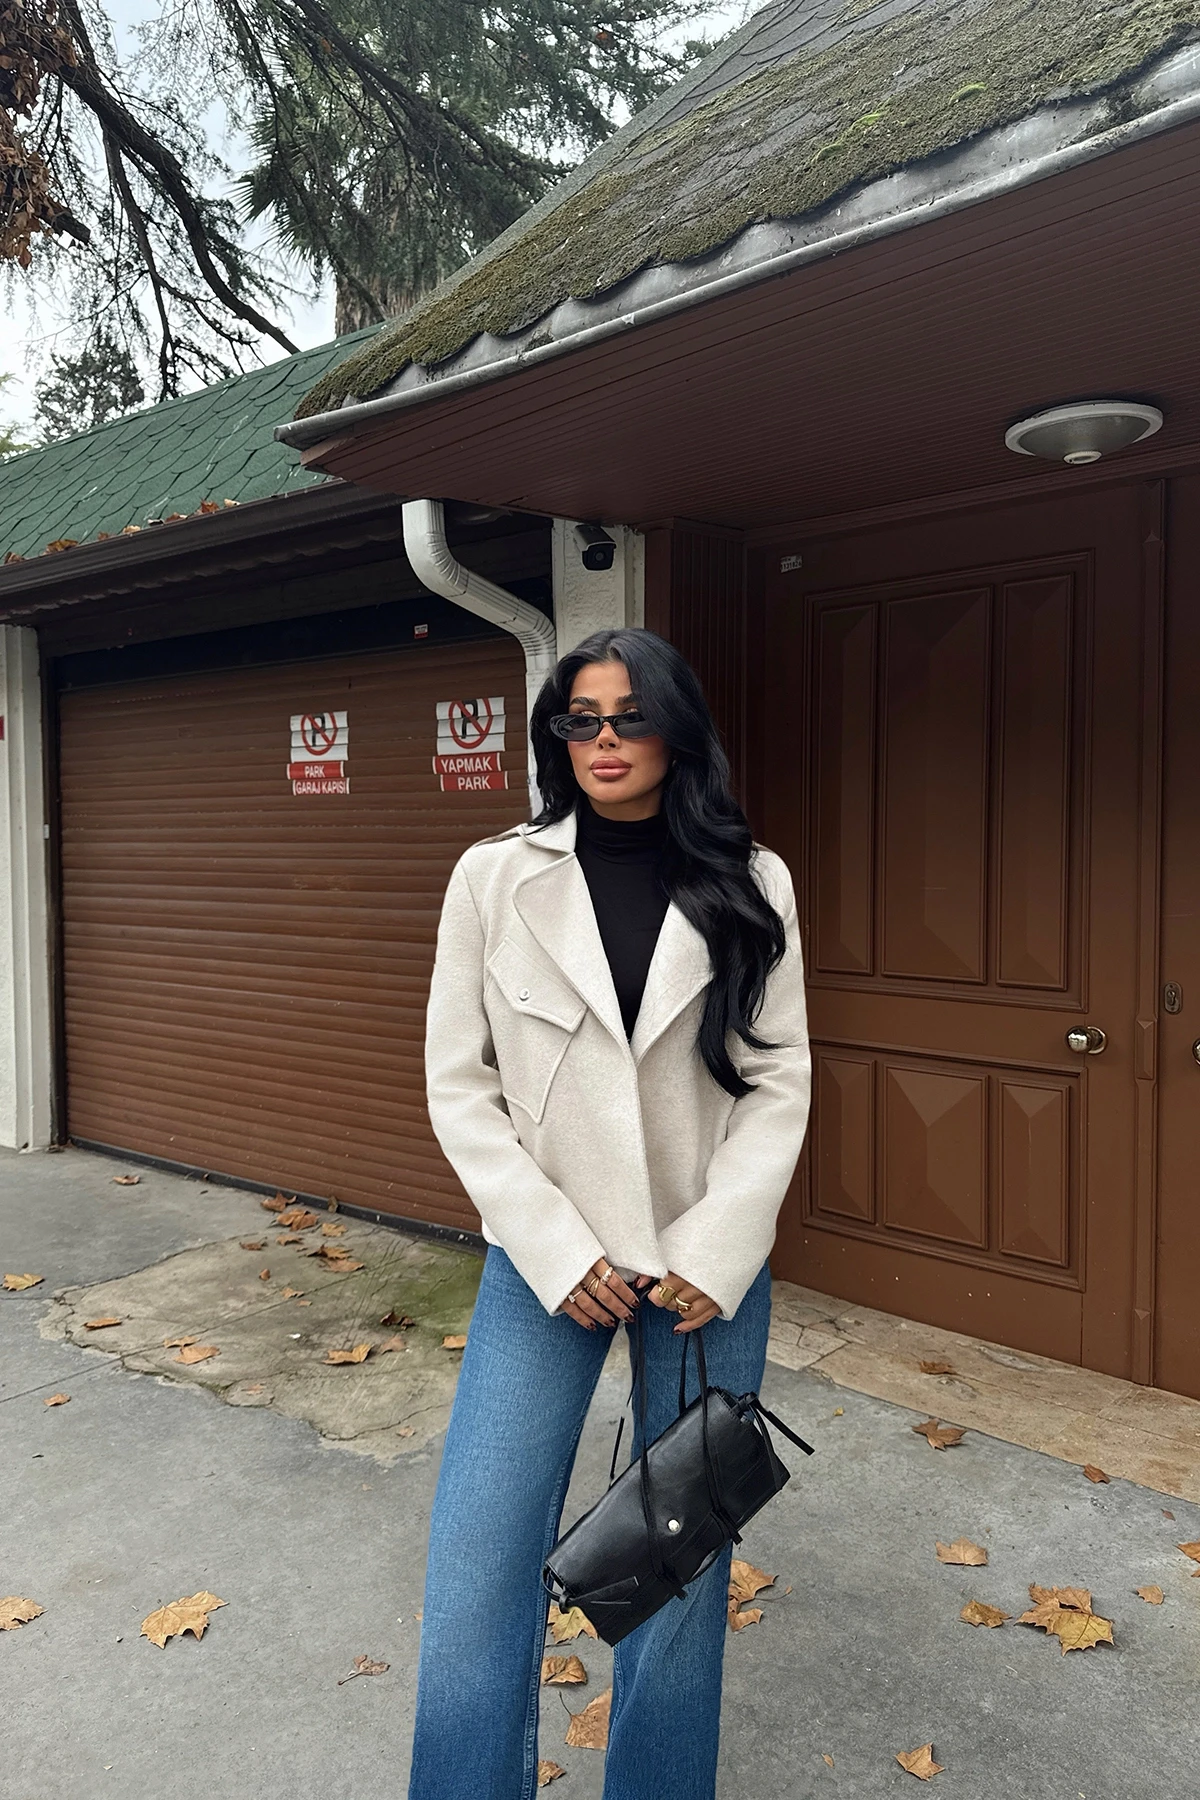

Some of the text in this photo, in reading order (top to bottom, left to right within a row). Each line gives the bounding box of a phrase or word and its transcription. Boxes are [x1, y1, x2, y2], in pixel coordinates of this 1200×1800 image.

[305, 765, 326, 778] PARK
[441, 756, 493, 773] YAPMAK
[295, 780, 346, 795] GARAJ KAPISI
[457, 775, 492, 790] PARK
